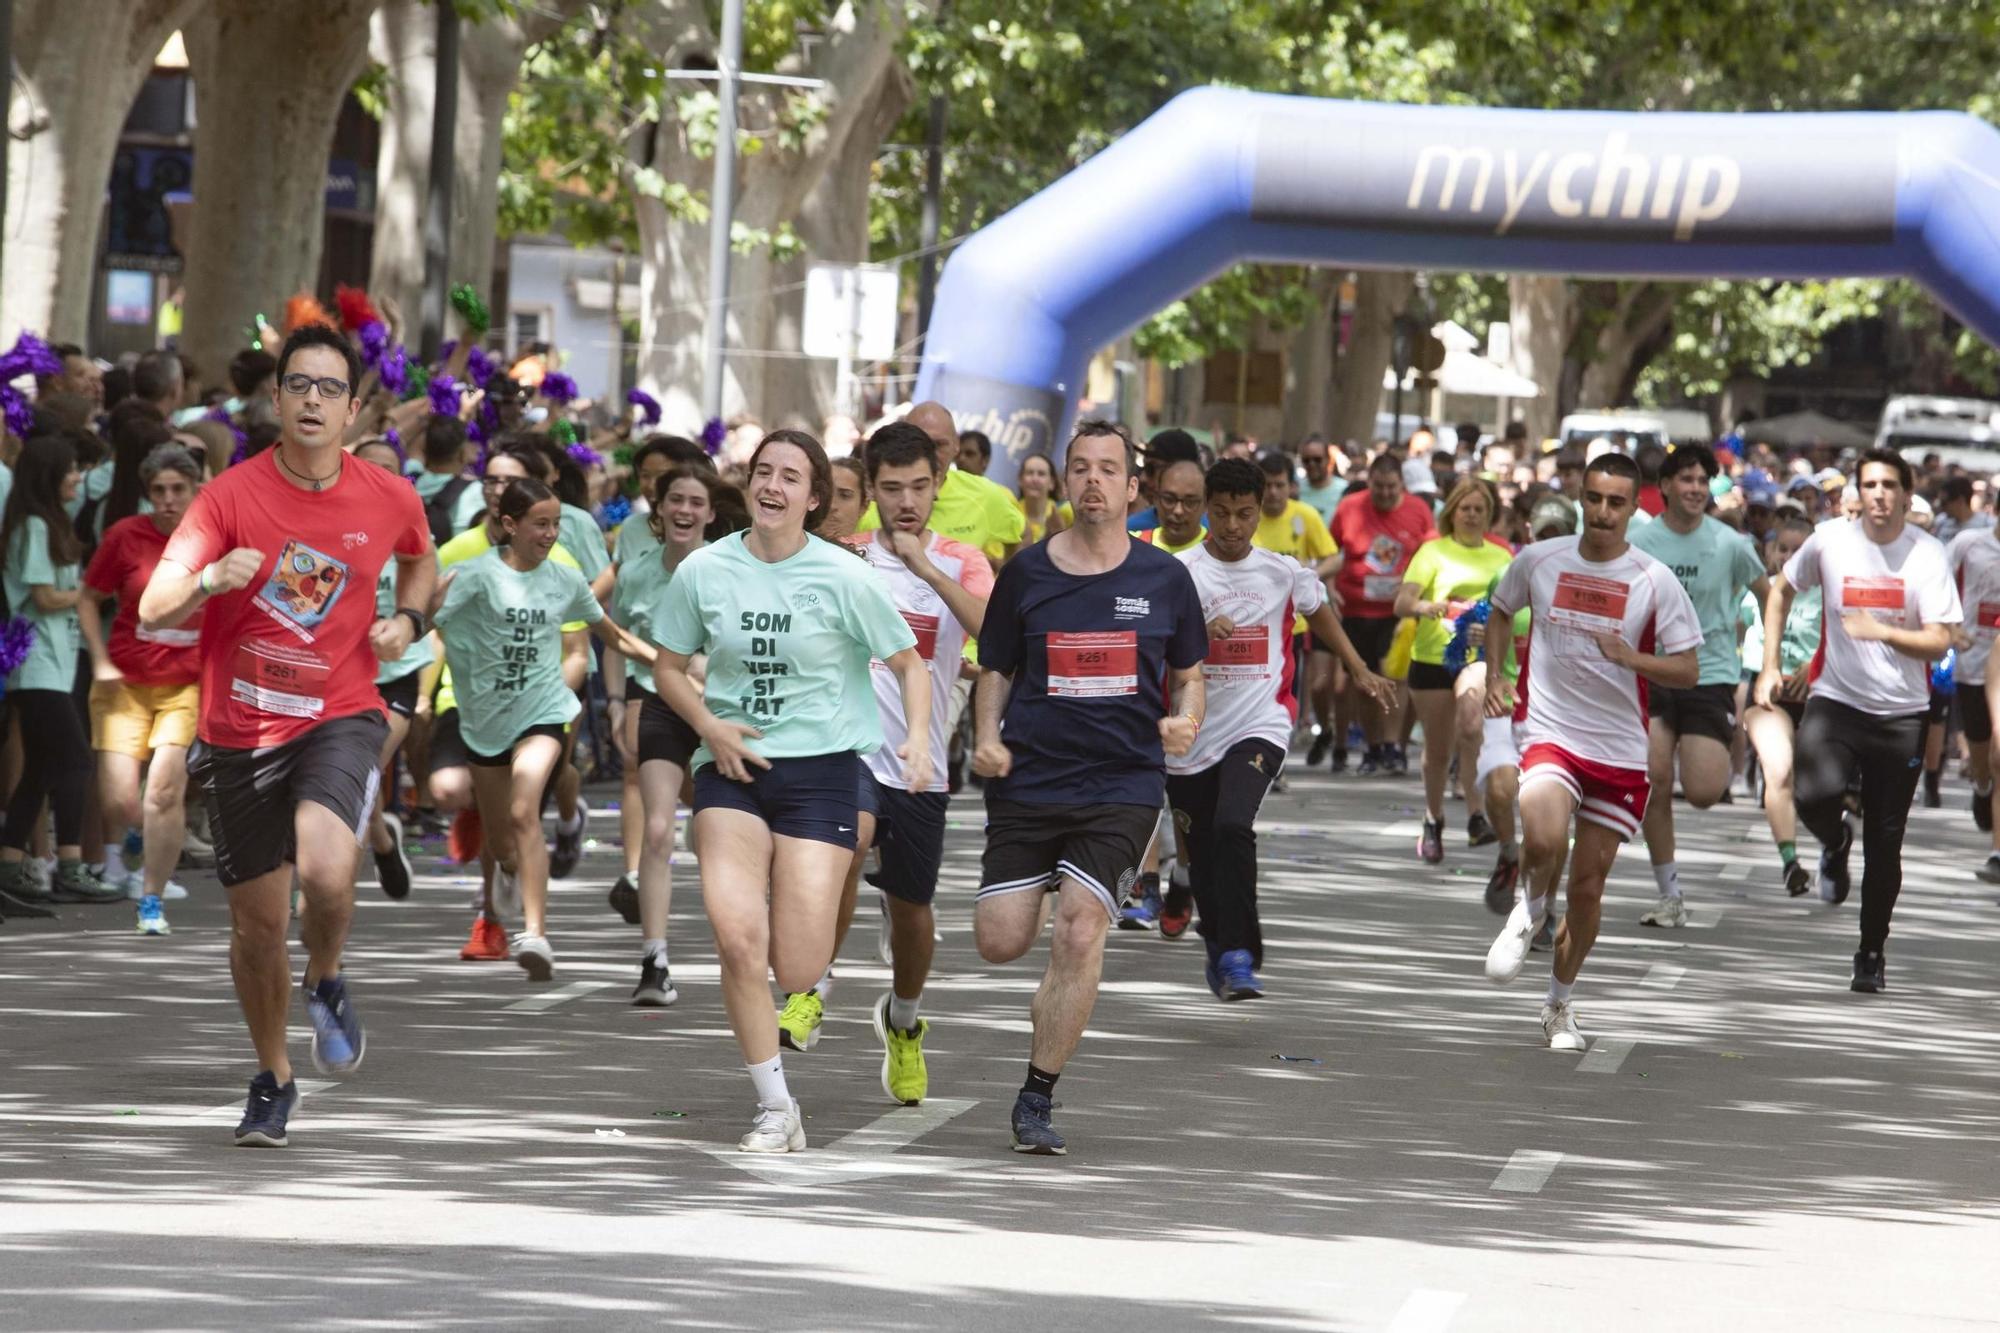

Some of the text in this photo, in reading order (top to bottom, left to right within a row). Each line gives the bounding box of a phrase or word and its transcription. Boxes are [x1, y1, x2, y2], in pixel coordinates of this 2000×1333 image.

[1406, 129, 1742, 241] mychip
[505, 607, 546, 625] SOM
[740, 611, 792, 633] SOM
[512, 627, 534, 643] DI
[503, 645, 538, 663] VER
[751, 637, 776, 657] DI
[264, 664, 297, 679] #261
[753, 678, 775, 696] SI
[739, 696, 785, 716] TAT
